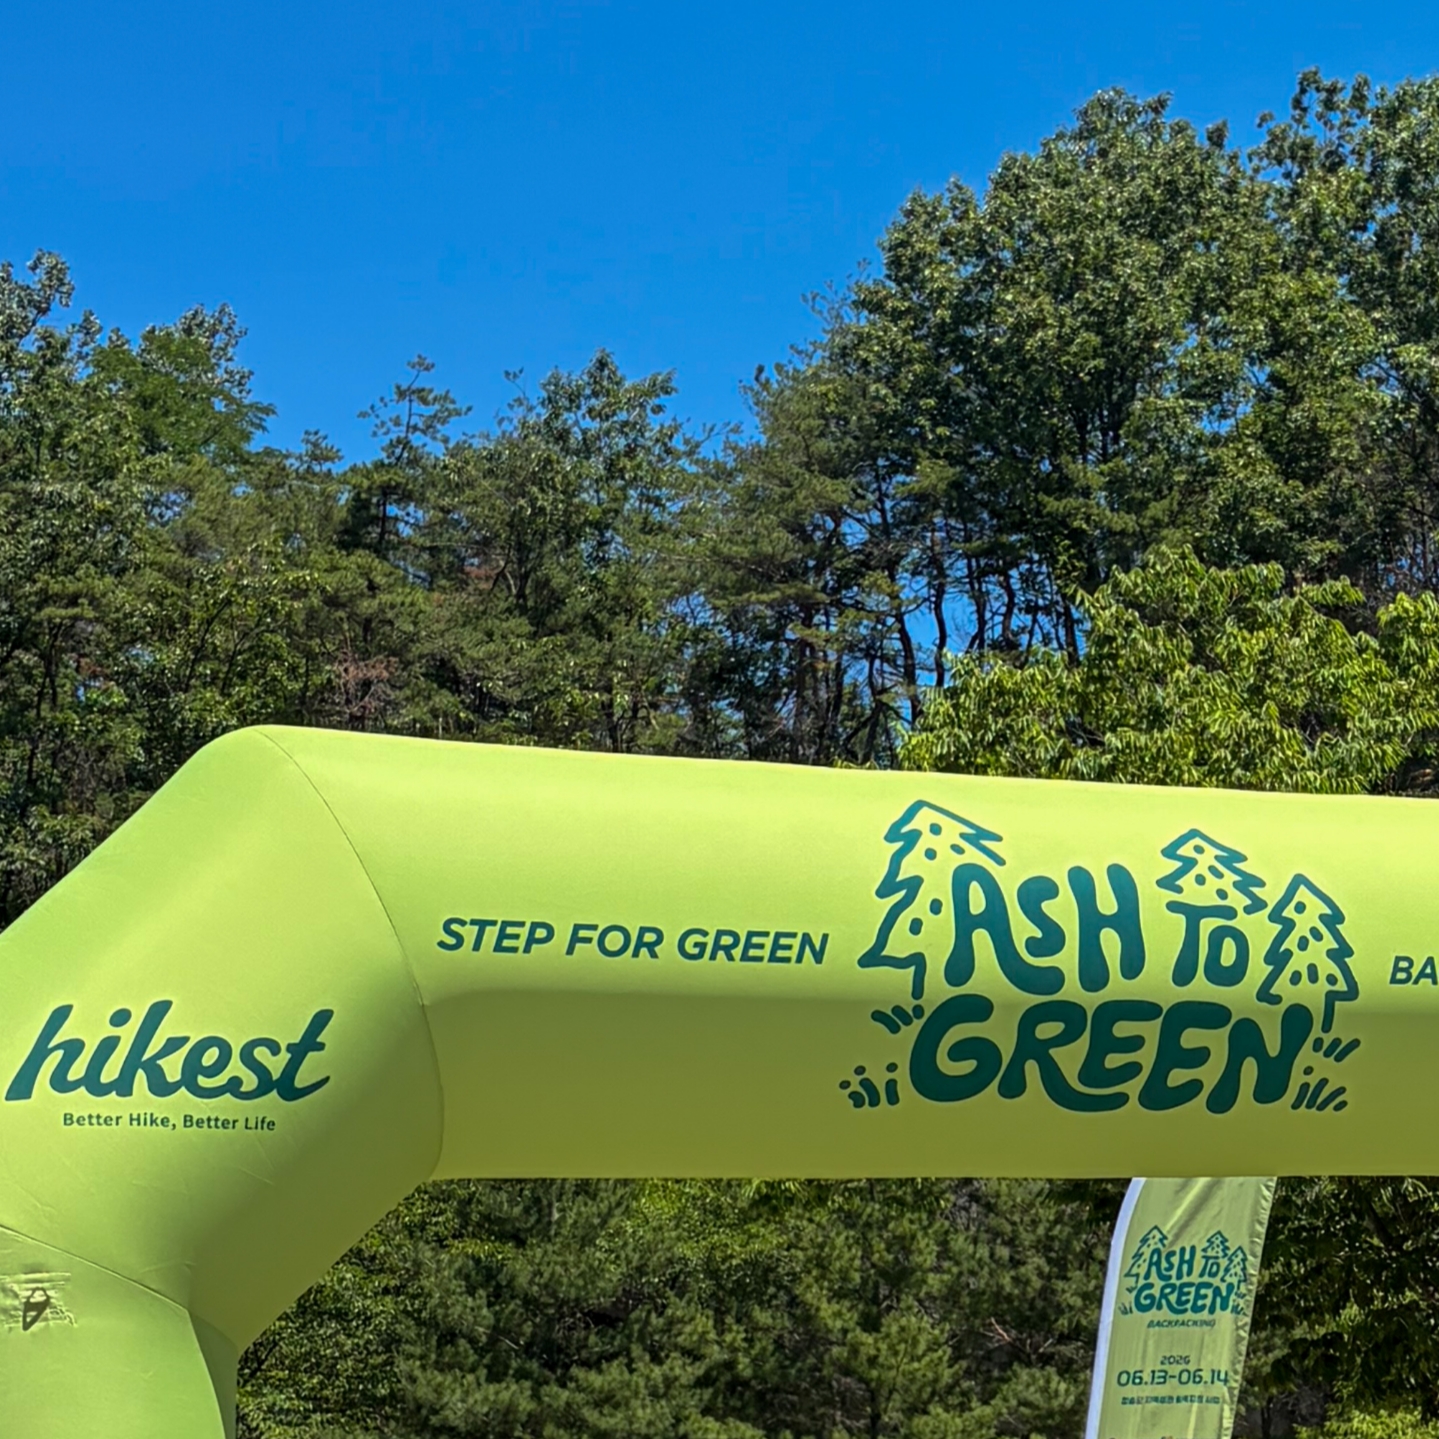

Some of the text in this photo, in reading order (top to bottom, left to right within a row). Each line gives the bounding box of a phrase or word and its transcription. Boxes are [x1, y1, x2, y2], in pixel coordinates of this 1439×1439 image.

[437, 916, 829, 964] STEP FOR GREEN
[943, 863, 1250, 995] ASH TO
[4, 999, 334, 1102] hikest
[909, 993, 1313, 1114] GREEN
[63, 1112, 276, 1132] Better Hike, Better Life
[1143, 1245, 1221, 1282] ASH TO
[1134, 1281, 1235, 1315] GREEN
[1117, 1368, 1229, 1387] 06.13-06.14
[1160, 1355, 1191, 1365] 2026
